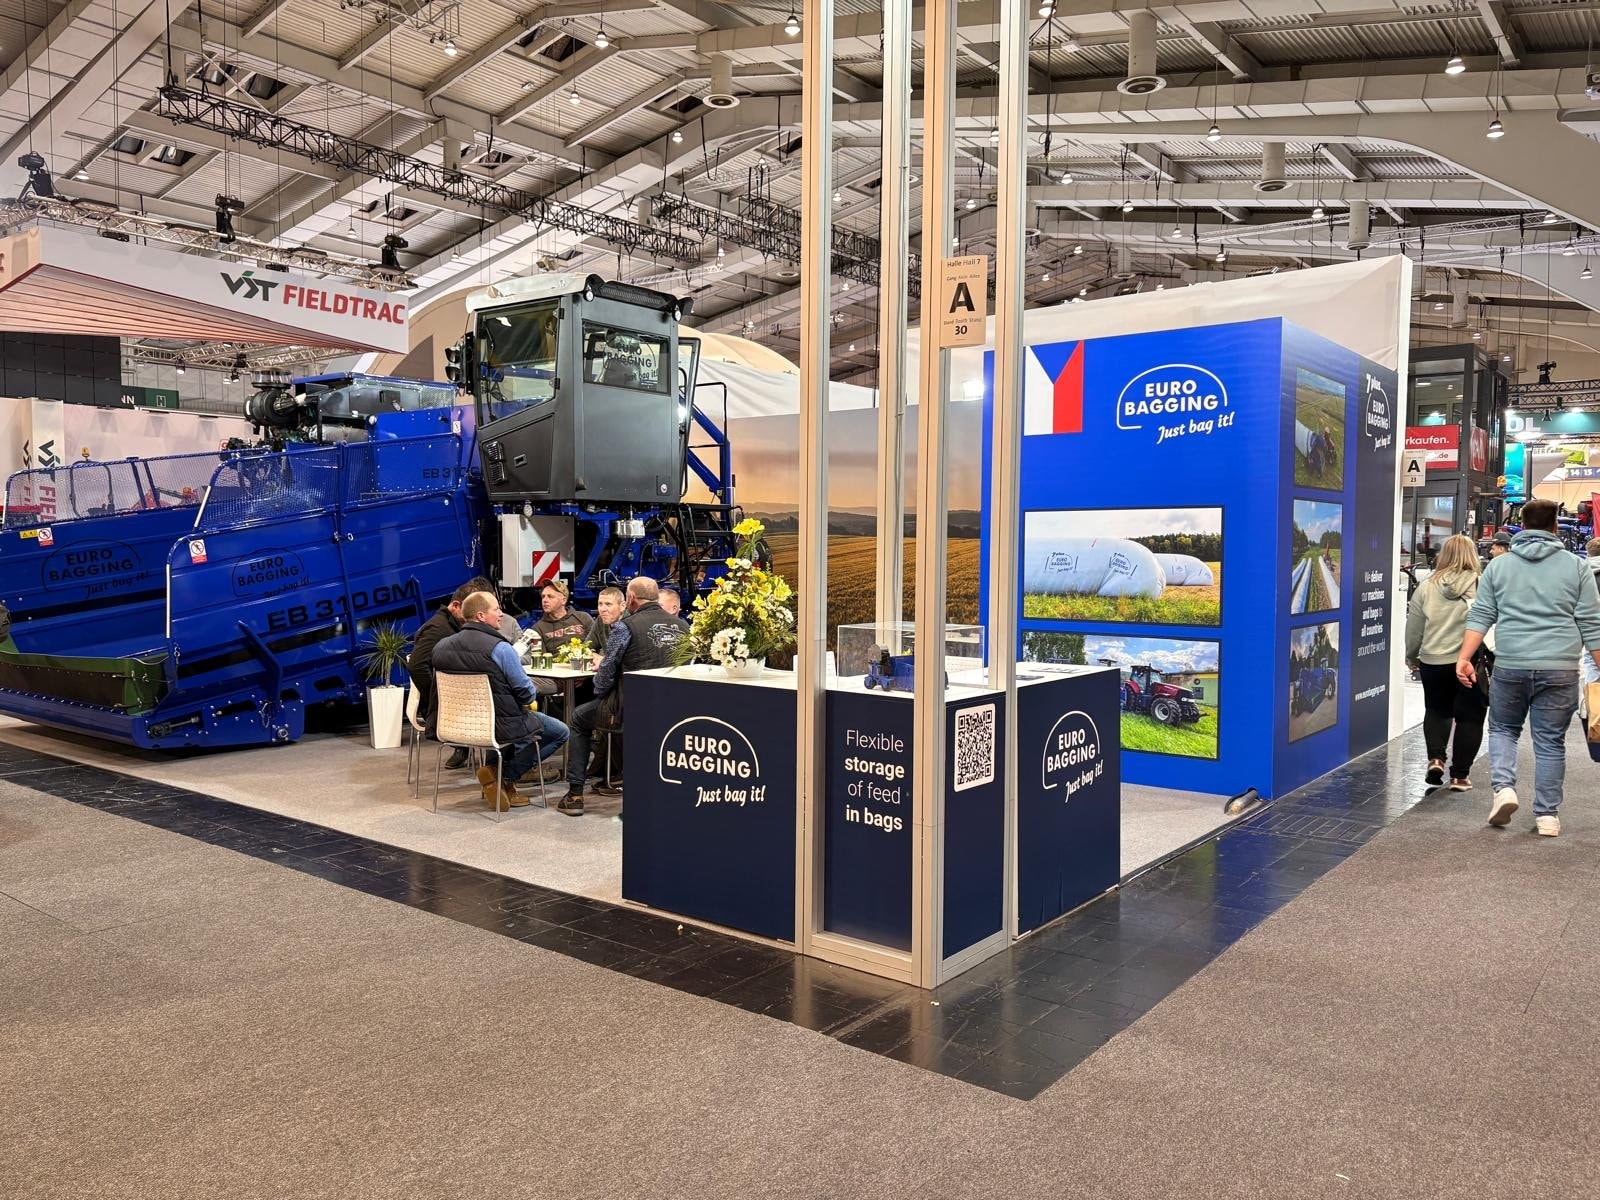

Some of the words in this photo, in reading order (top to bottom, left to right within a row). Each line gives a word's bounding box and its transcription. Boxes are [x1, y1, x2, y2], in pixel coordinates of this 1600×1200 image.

[283, 284, 406, 324] FIELDTRAC
[949, 282, 976, 313] A
[954, 326, 968, 335] 30
[607, 352, 652, 368] BAGGING
[1145, 380, 1197, 398] EURO
[1124, 394, 1219, 416] BAGGING
[1372, 400, 1384, 415] EURO
[1156, 424, 1186, 444] Just
[1188, 419, 1214, 434] bag
[1217, 412, 1235, 428] it!
[1368, 412, 1388, 430] BAGGING
[423, 468, 440, 478] EB
[1407, 460, 1420, 472] A
[66, 549, 112, 566] EURO
[250, 556, 284, 572] EURO
[49, 560, 134, 580] BAGGING
[237, 566, 299, 587] BAGGING
[266, 604, 309, 631] EB
[684, 734, 732, 756] EURO
[846, 730, 904, 752] Flexible
[1058, 728, 1086, 750] EURO
[666, 750, 751, 778] BAGGING
[844, 756, 905, 781] storage
[1047, 744, 1096, 772] BAGGING
[848, 780, 864, 797] of
[867, 782, 901, 804] feed
[1064, 776, 1080, 804] Just
[1082, 770, 1094, 786] bag
[1095, 759, 1104, 778] it!
[696, 786, 721, 808] Just
[724, 784, 746, 806] bag
[750, 784, 766, 802] it!
[846, 804, 860, 822] in
[864, 806, 903, 832] bags
